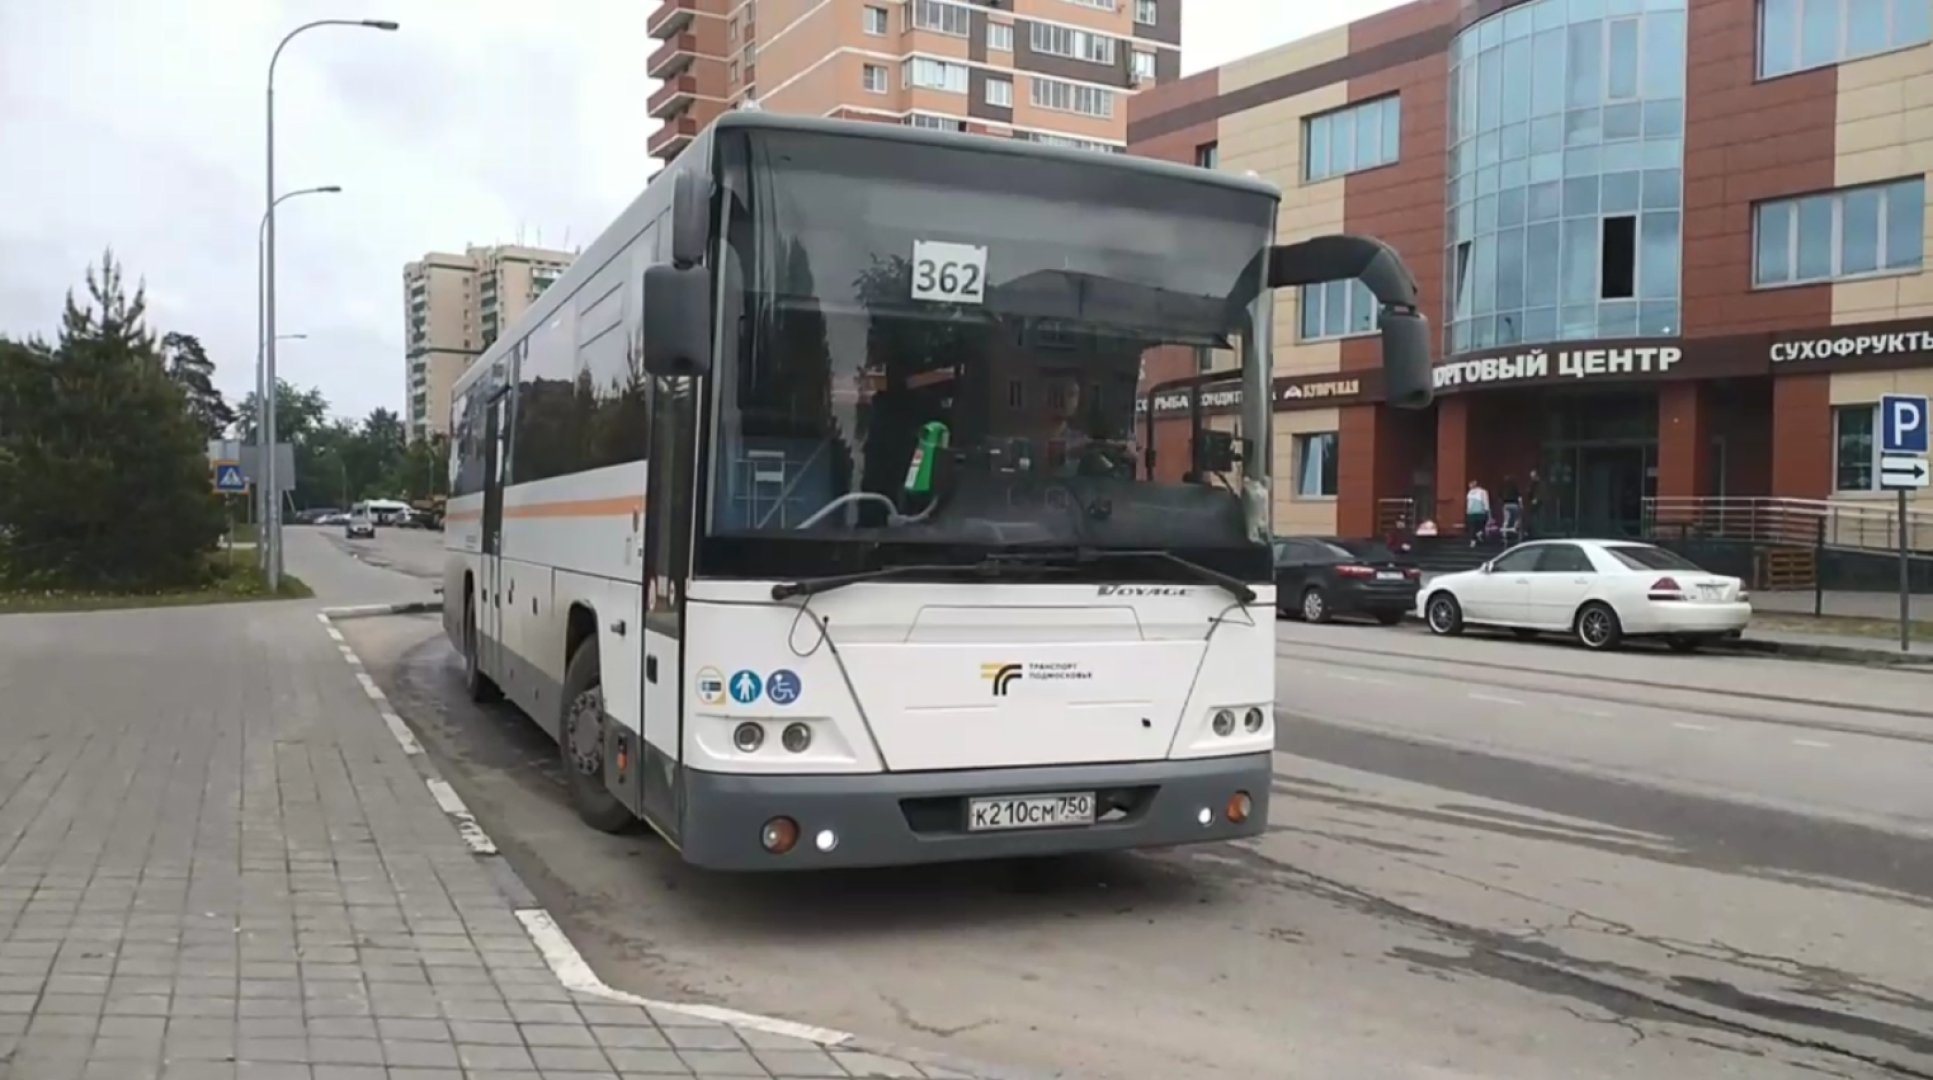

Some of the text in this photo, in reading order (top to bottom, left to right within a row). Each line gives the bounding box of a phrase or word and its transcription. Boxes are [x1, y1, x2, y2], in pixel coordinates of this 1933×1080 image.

[916, 259, 980, 296] 362
[1432, 347, 1682, 388] ОРГОВЫЙ ЦЕНТР
[1154, 394, 1189, 411] РЫБА
[1894, 401, 1921, 446] P
[1028, 662, 1078, 671] ТРАНСПОРТ
[1028, 671, 1093, 681] ПОДМОСКОВЬЯ
[1059, 796, 1089, 816] 750
